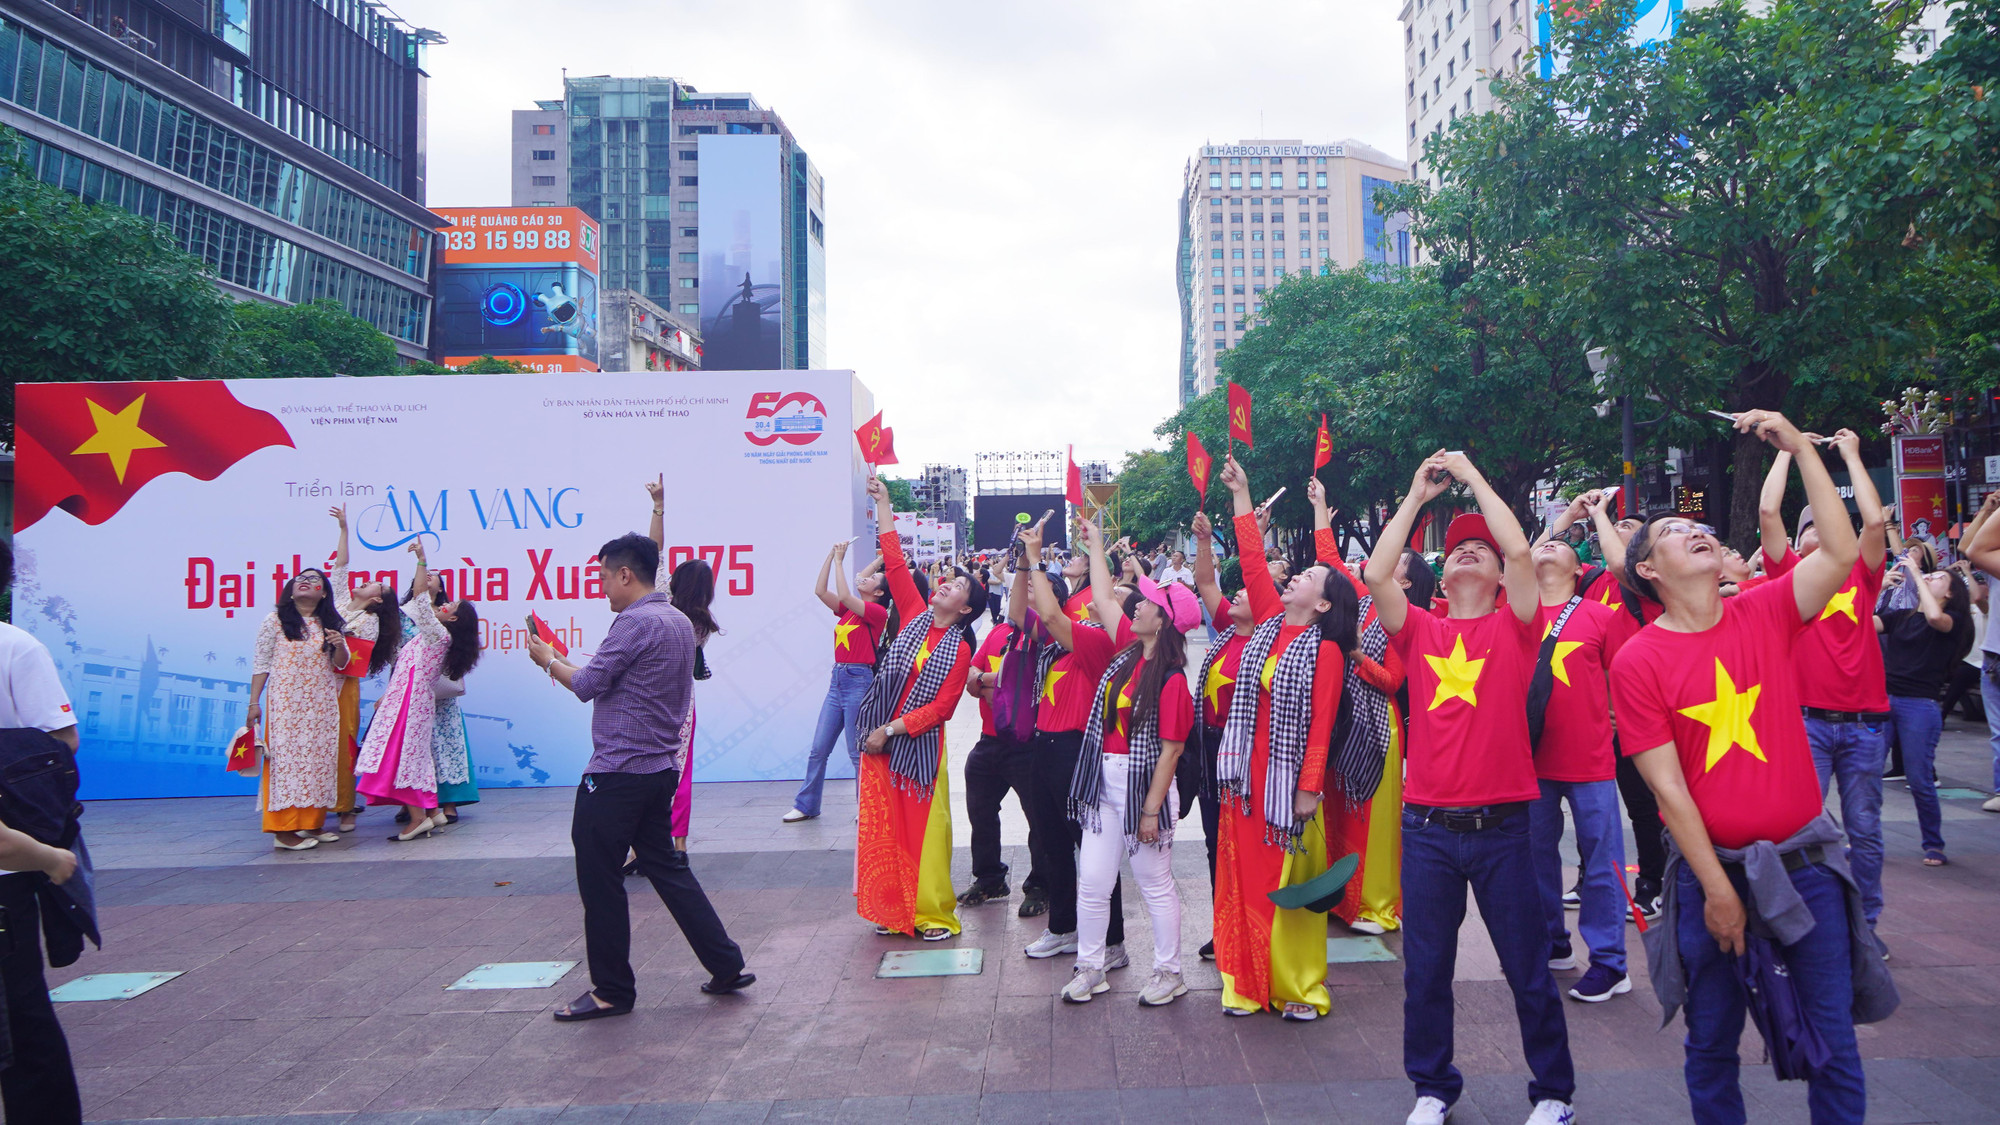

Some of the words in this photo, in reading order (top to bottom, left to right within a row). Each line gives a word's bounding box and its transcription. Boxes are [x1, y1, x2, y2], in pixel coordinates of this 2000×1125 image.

[1217, 146, 1270, 155] HARBOUR
[1274, 146, 1300, 155] VIEW
[1304, 145, 1343, 155] TOWER
[462, 215, 476, 228] HỆ
[480, 214, 518, 227] QUẢNG
[522, 213, 544, 226] CÁO
[548, 215, 562, 225] 3D
[484, 231, 507, 250] 15
[513, 230, 539, 249] 99
[544, 230, 570, 249] 88
[556, 399, 574, 407] BAN
[576, 398, 601, 407] NHÂN
[603, 398, 621, 407] DÂN
[624, 397, 654, 406] THÀNH
[656, 396, 673, 405] PHỐ
[689, 396, 703, 405] CHÍ
[705, 397, 729, 405] MINH
[281, 405, 292, 414] BỘ
[294, 405, 310, 413] VĂN
[337, 402, 353, 413] THỂ
[355, 404, 379, 412] THAO
[380, 403, 392, 412] VÀ
[394, 404, 406, 412] DU
[583, 409, 593, 418] SỞ
[596, 409, 613, 418] VĂN
[615, 408, 633, 418] HÓA
[635, 408, 647, 417] VÀ
[648, 407, 665, 417] THỂ
[667, 409, 690, 417] THAO
[311, 416, 331, 426] VIỆN
[333, 417, 355, 425] PHIM
[357, 416, 376, 425] VIỆT
[755, 421, 770, 429] 30.4
[1905, 446, 1933, 454] HDBank
[284, 478, 332, 497] Triển
[340, 481, 374, 496] lãm
[357, 485, 448, 551] ÂM
[468, 487, 584, 530] VANG
[184, 556, 255, 618] Đại
[478, 618, 528, 654] Điện
[543, 616, 582, 649] nh
